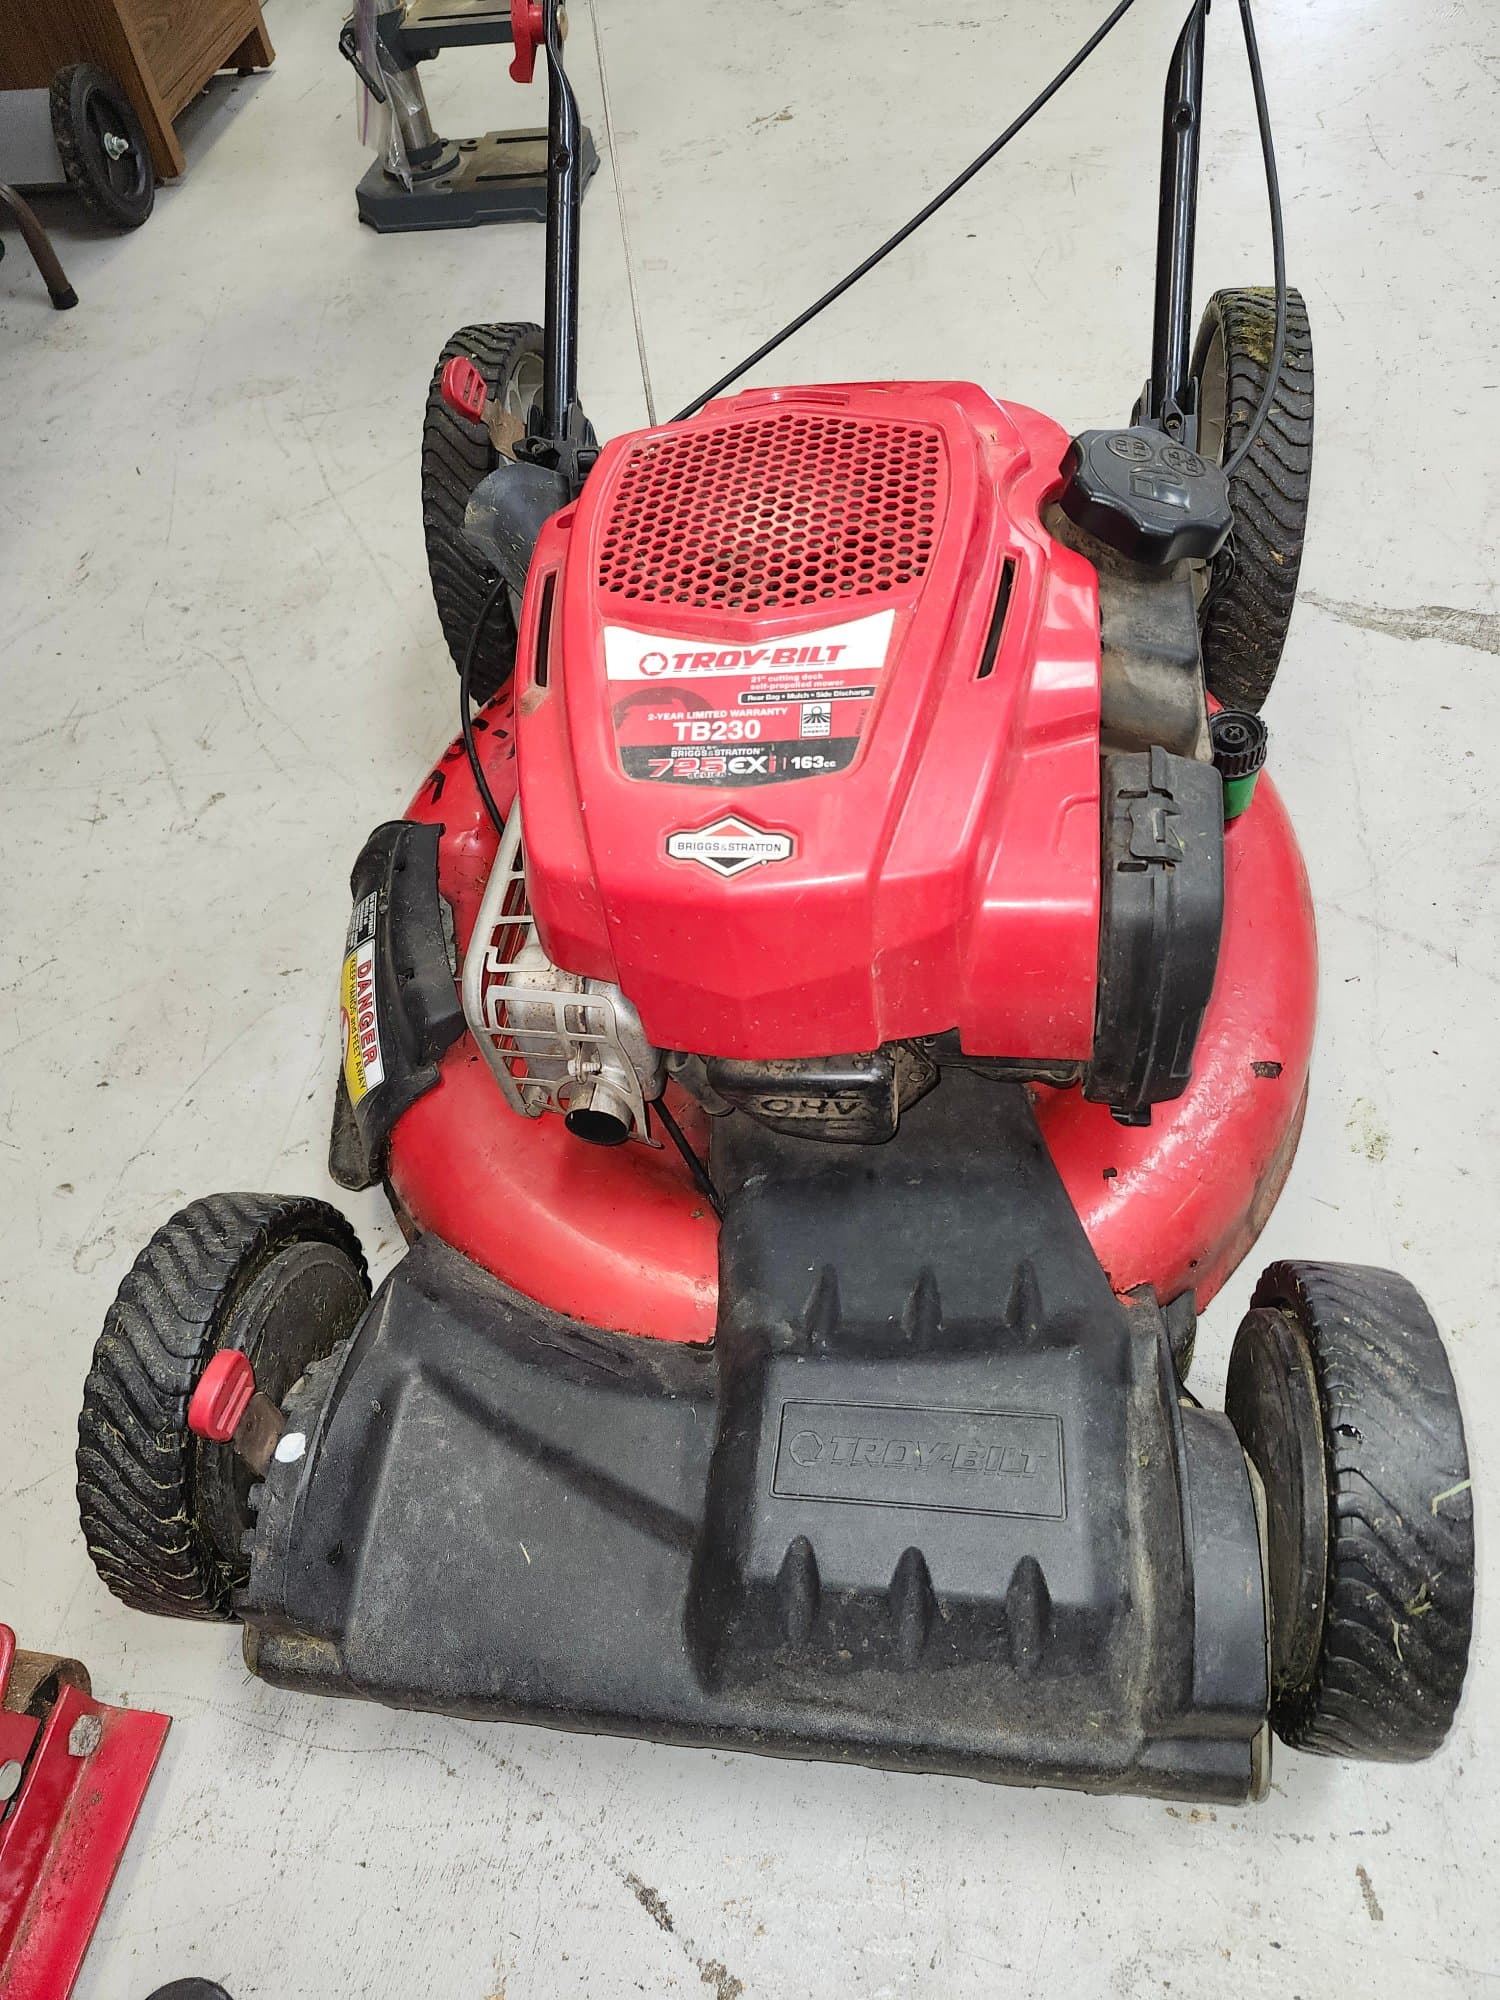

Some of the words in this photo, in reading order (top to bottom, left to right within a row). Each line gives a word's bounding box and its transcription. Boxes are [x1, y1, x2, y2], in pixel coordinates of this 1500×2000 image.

[672, 645, 847, 672] TROY-BILT
[750, 681, 812, 691] self-propelled
[814, 680, 844, 688] mower
[768, 674, 799, 684] cutting
[801, 672, 823, 681] deck
[766, 693, 780, 702] Bag
[787, 692, 810, 700] Mulch
[816, 690, 832, 698] Side
[833, 688, 870, 698] Discharge
[647, 712, 684, 721] 2-YEAR
[686, 710, 727, 719] LIMITED
[730, 707, 788, 718] WARRANTY
[672, 719, 761, 742] TB230
[791, 756, 836, 770] 163cc
[348, 984, 356, 1016] HANDS
[357, 960, 378, 1067] DANGER
[351, 1033, 362, 1060] FEET
[355, 1061, 367, 1090] AWAY
[830, 1435, 1047, 1479] TROY-BILT
